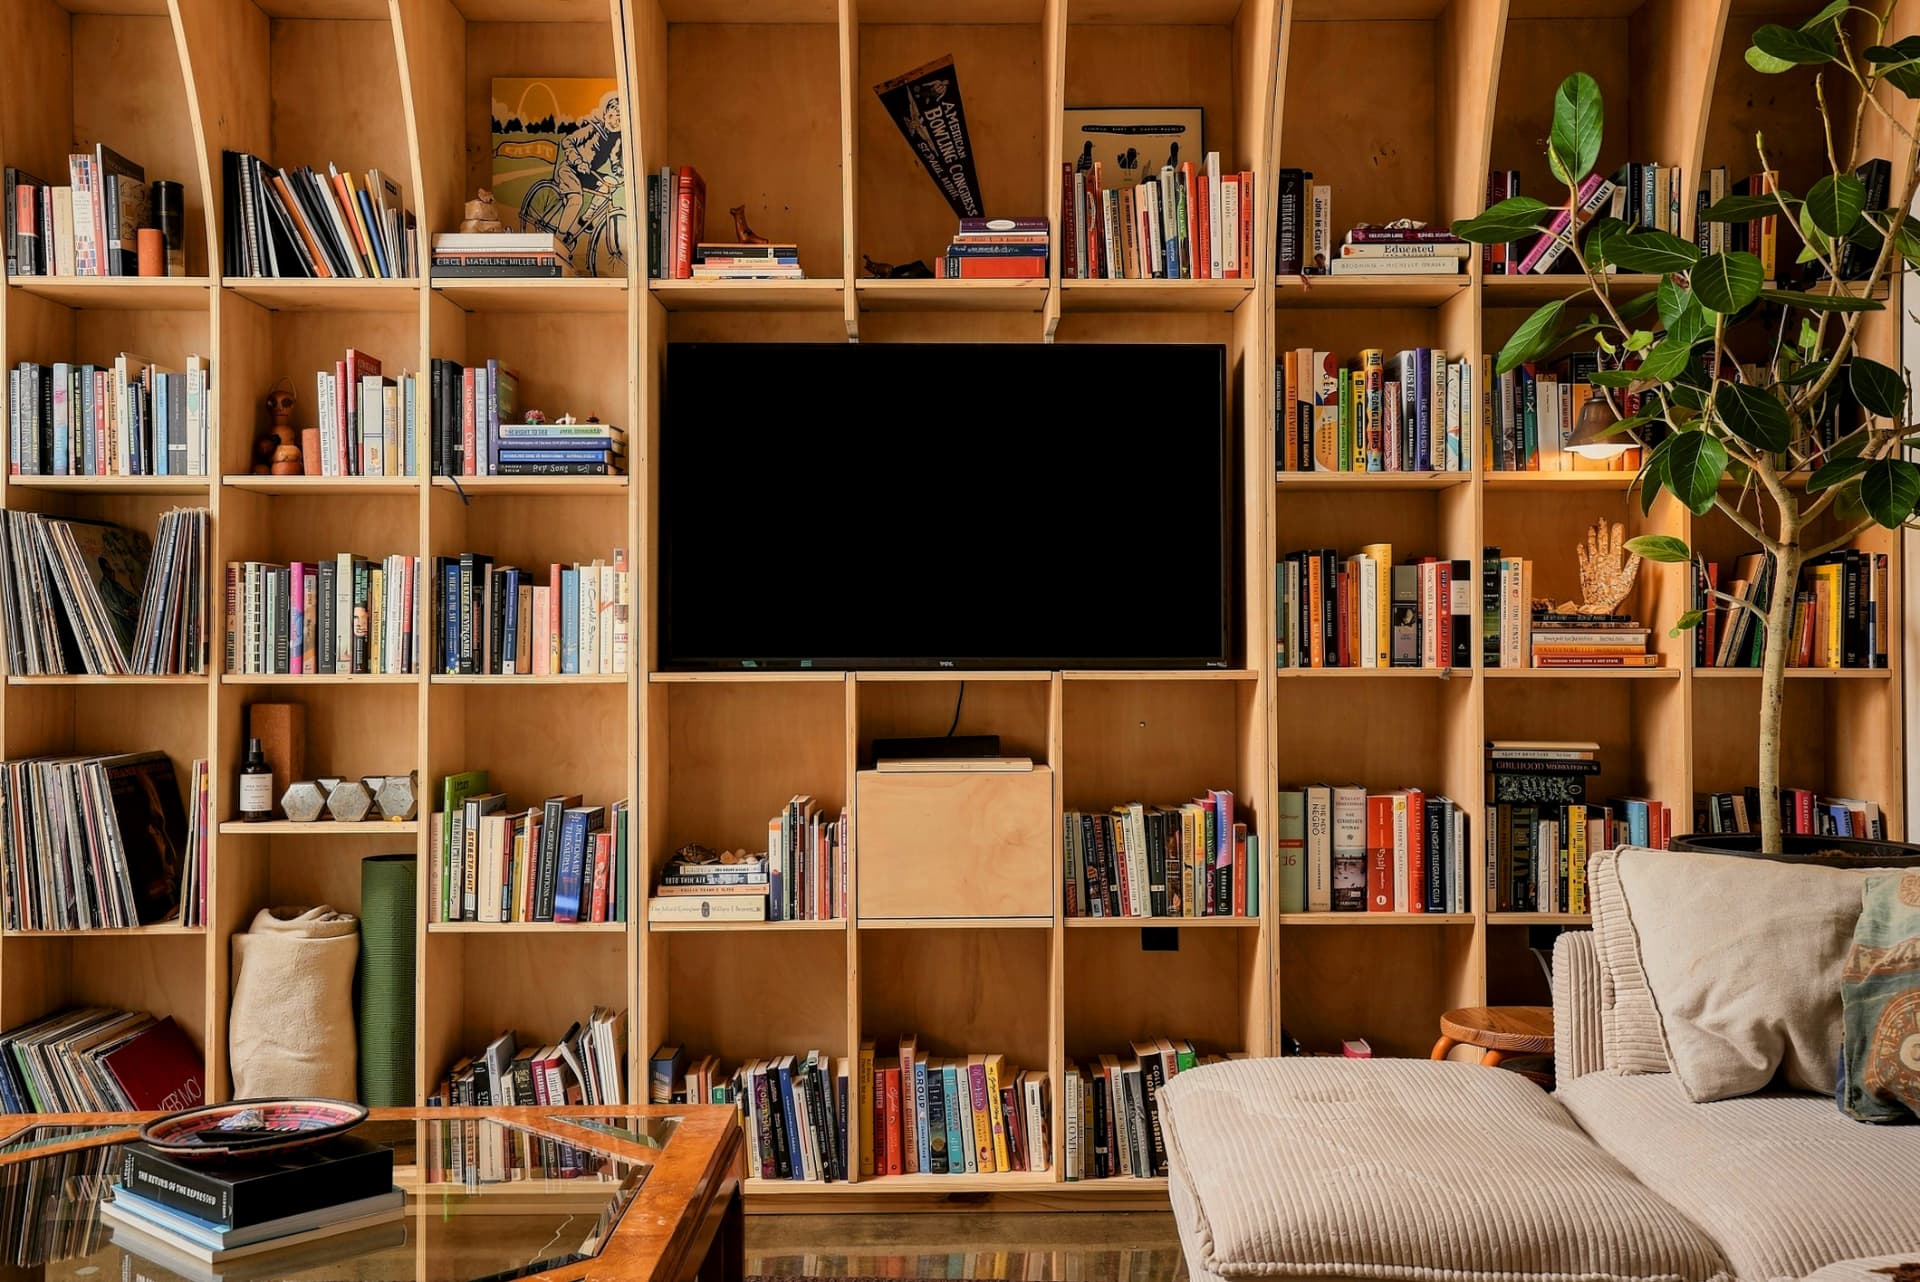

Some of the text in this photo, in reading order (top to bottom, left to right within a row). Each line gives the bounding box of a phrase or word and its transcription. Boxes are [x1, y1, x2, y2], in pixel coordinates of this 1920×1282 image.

[942, 101, 966, 159] AMERICAN
[924, 105, 979, 217] BOWLING CONGRESS
[1314, 198, 1322, 218] John
[1282, 194, 1292, 262] SHERLOCK HOLMES
[436, 258, 538, 266] CIRCE MADELINE MILLER
[1384, 245, 1434, 254] Educated
[1407, 368, 1415, 402] JUST US
[1436, 355, 1445, 397] ALL FOURS
[1288, 385, 1296, 400] THE
[550, 464, 569, 472] Song
[1512, 562, 1520, 586] CARRY
[227, 590, 236, 616] FEELINGS
[587, 589, 596, 624] Complete
[1512, 624, 1520, 650] JENSEN
[1312, 803, 1320, 836] NEGRO
[1431, 814, 1440, 829] LAST
[562, 824, 572, 873] THESAURUS
[572, 824, 583, 876] DICTIONARY
[1415, 833, 1422, 841] OF
[1431, 830, 1440, 850] NIGHT
[543, 851, 552, 898] EXPECTATIONS
[1431, 888, 1440, 904] CLUB
[916, 1070, 926, 1108] GROUP
[138, 1170, 147, 1182] THE
[148, 1174, 168, 1190] RETURN
[168, 1182, 176, 1191] OF
[176, 1184, 186, 1194] THE
